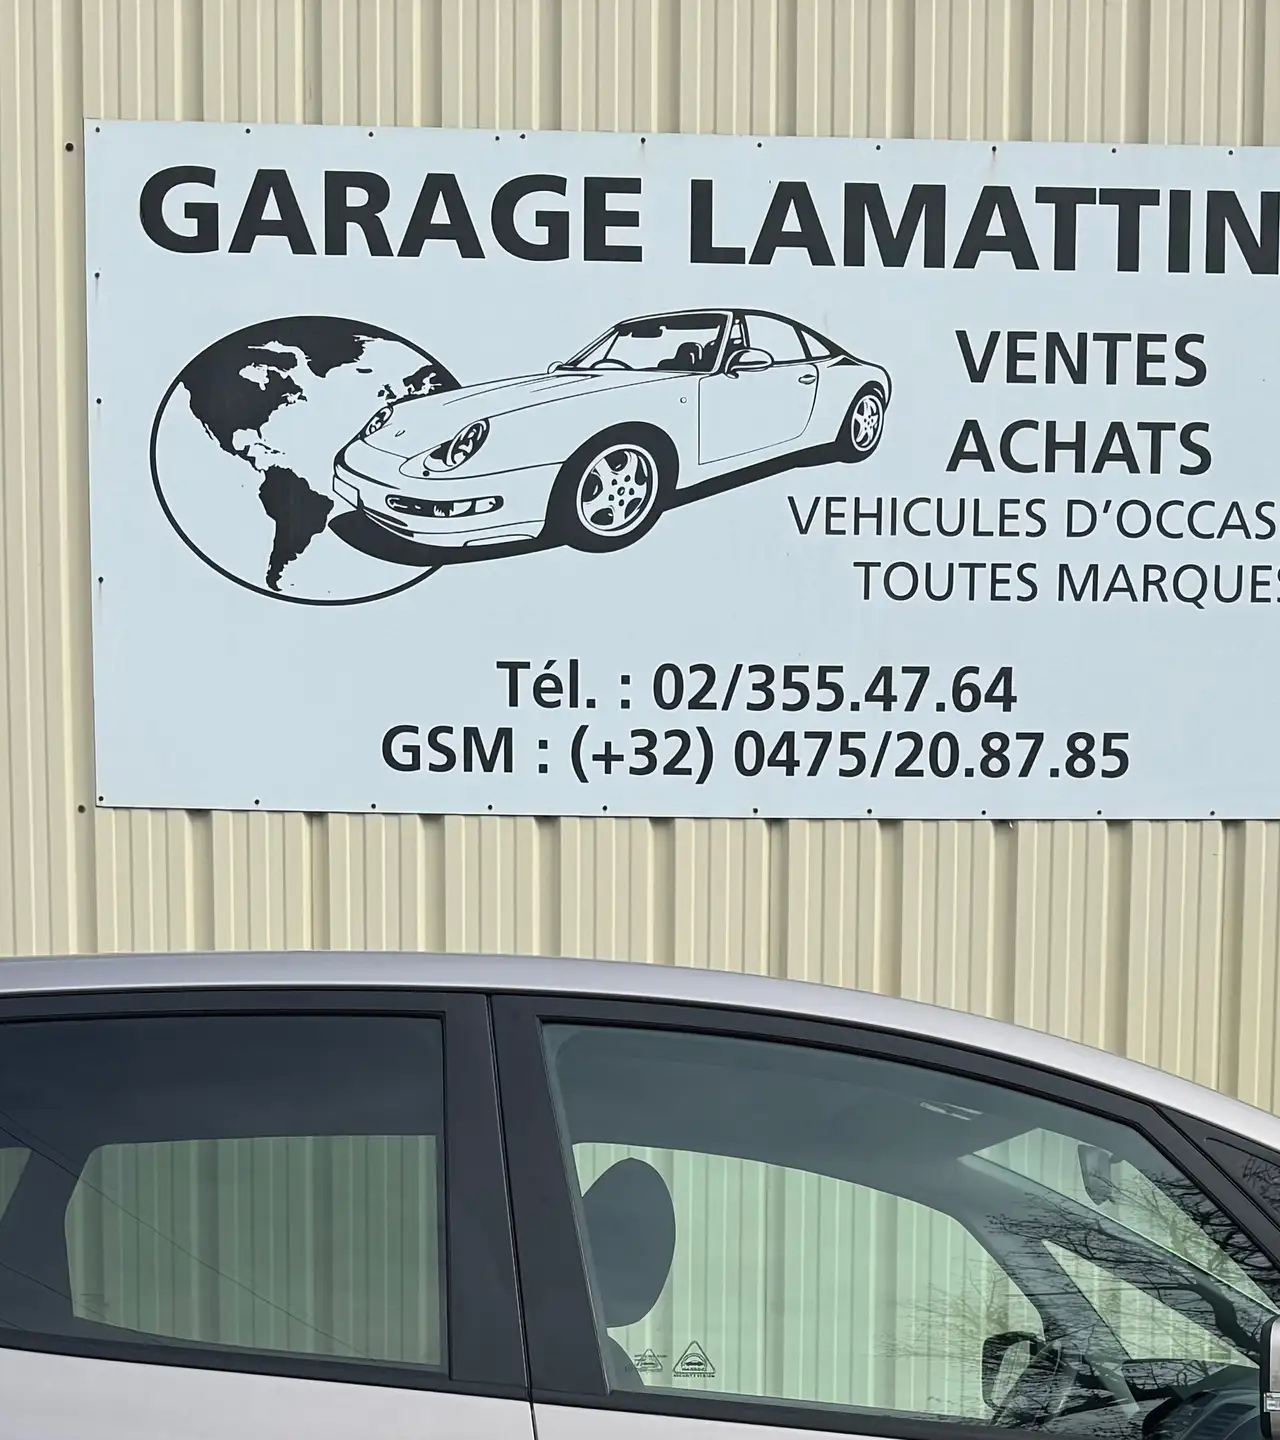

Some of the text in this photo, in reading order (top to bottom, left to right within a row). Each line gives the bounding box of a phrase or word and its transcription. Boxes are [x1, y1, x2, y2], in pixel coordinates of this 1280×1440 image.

[140, 165, 642, 263] GARAGE
[955, 330, 1207, 388] VENTES
[946, 420, 1212, 476] ACHATS
[788, 496, 1047, 540] VEHICULES
[853, 561, 1038, 602] TOUTES
[497, 658, 596, 710] Tél.
[653, 662, 1018, 714] 02/355.47.64
[381, 724, 513, 775] GSM
[570, 724, 714, 785] (+32)
[734, 729, 1129, 782] 0475/20.87.85
